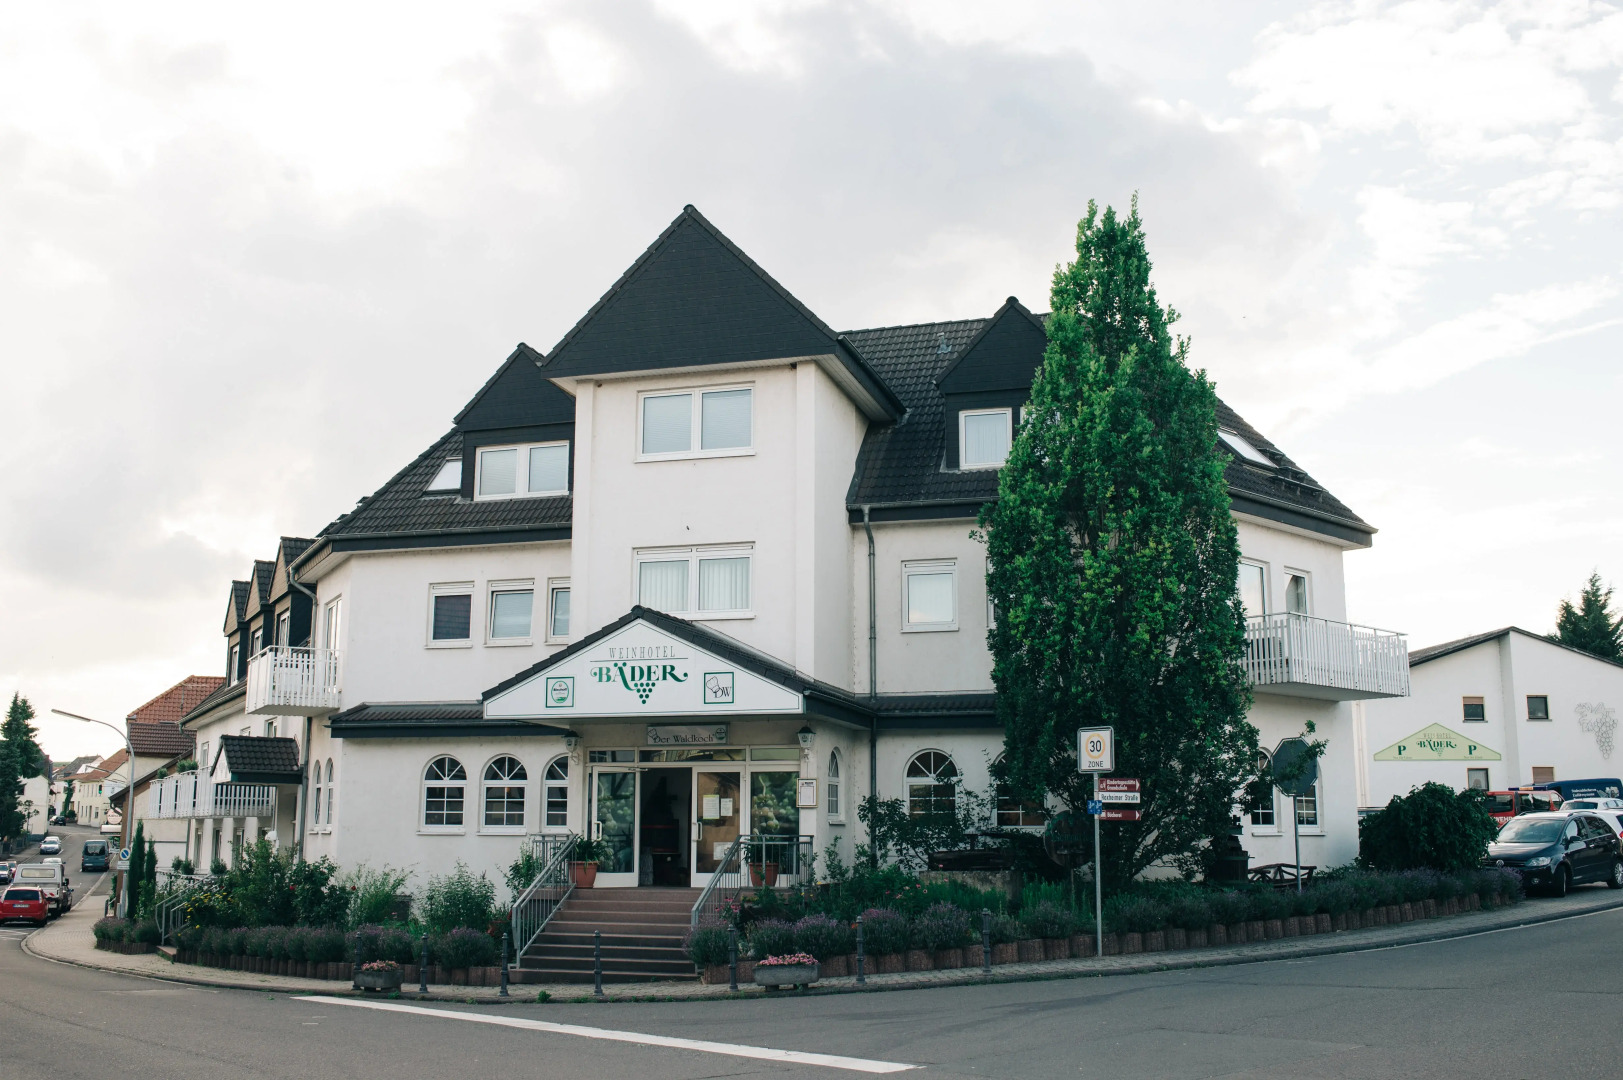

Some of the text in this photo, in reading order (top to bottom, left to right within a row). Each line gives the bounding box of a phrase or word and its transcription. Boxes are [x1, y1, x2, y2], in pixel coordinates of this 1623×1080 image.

[608, 646, 676, 659] WEINHOTEL
[590, 662, 689, 691] BÄDER
[673, 734, 714, 744] Waldkoch
[1416, 739, 1457, 752] BÄDER
[1089, 740, 1102, 753] 30
[1397, 745, 1407, 755] P
[1468, 745, 1477, 755] P
